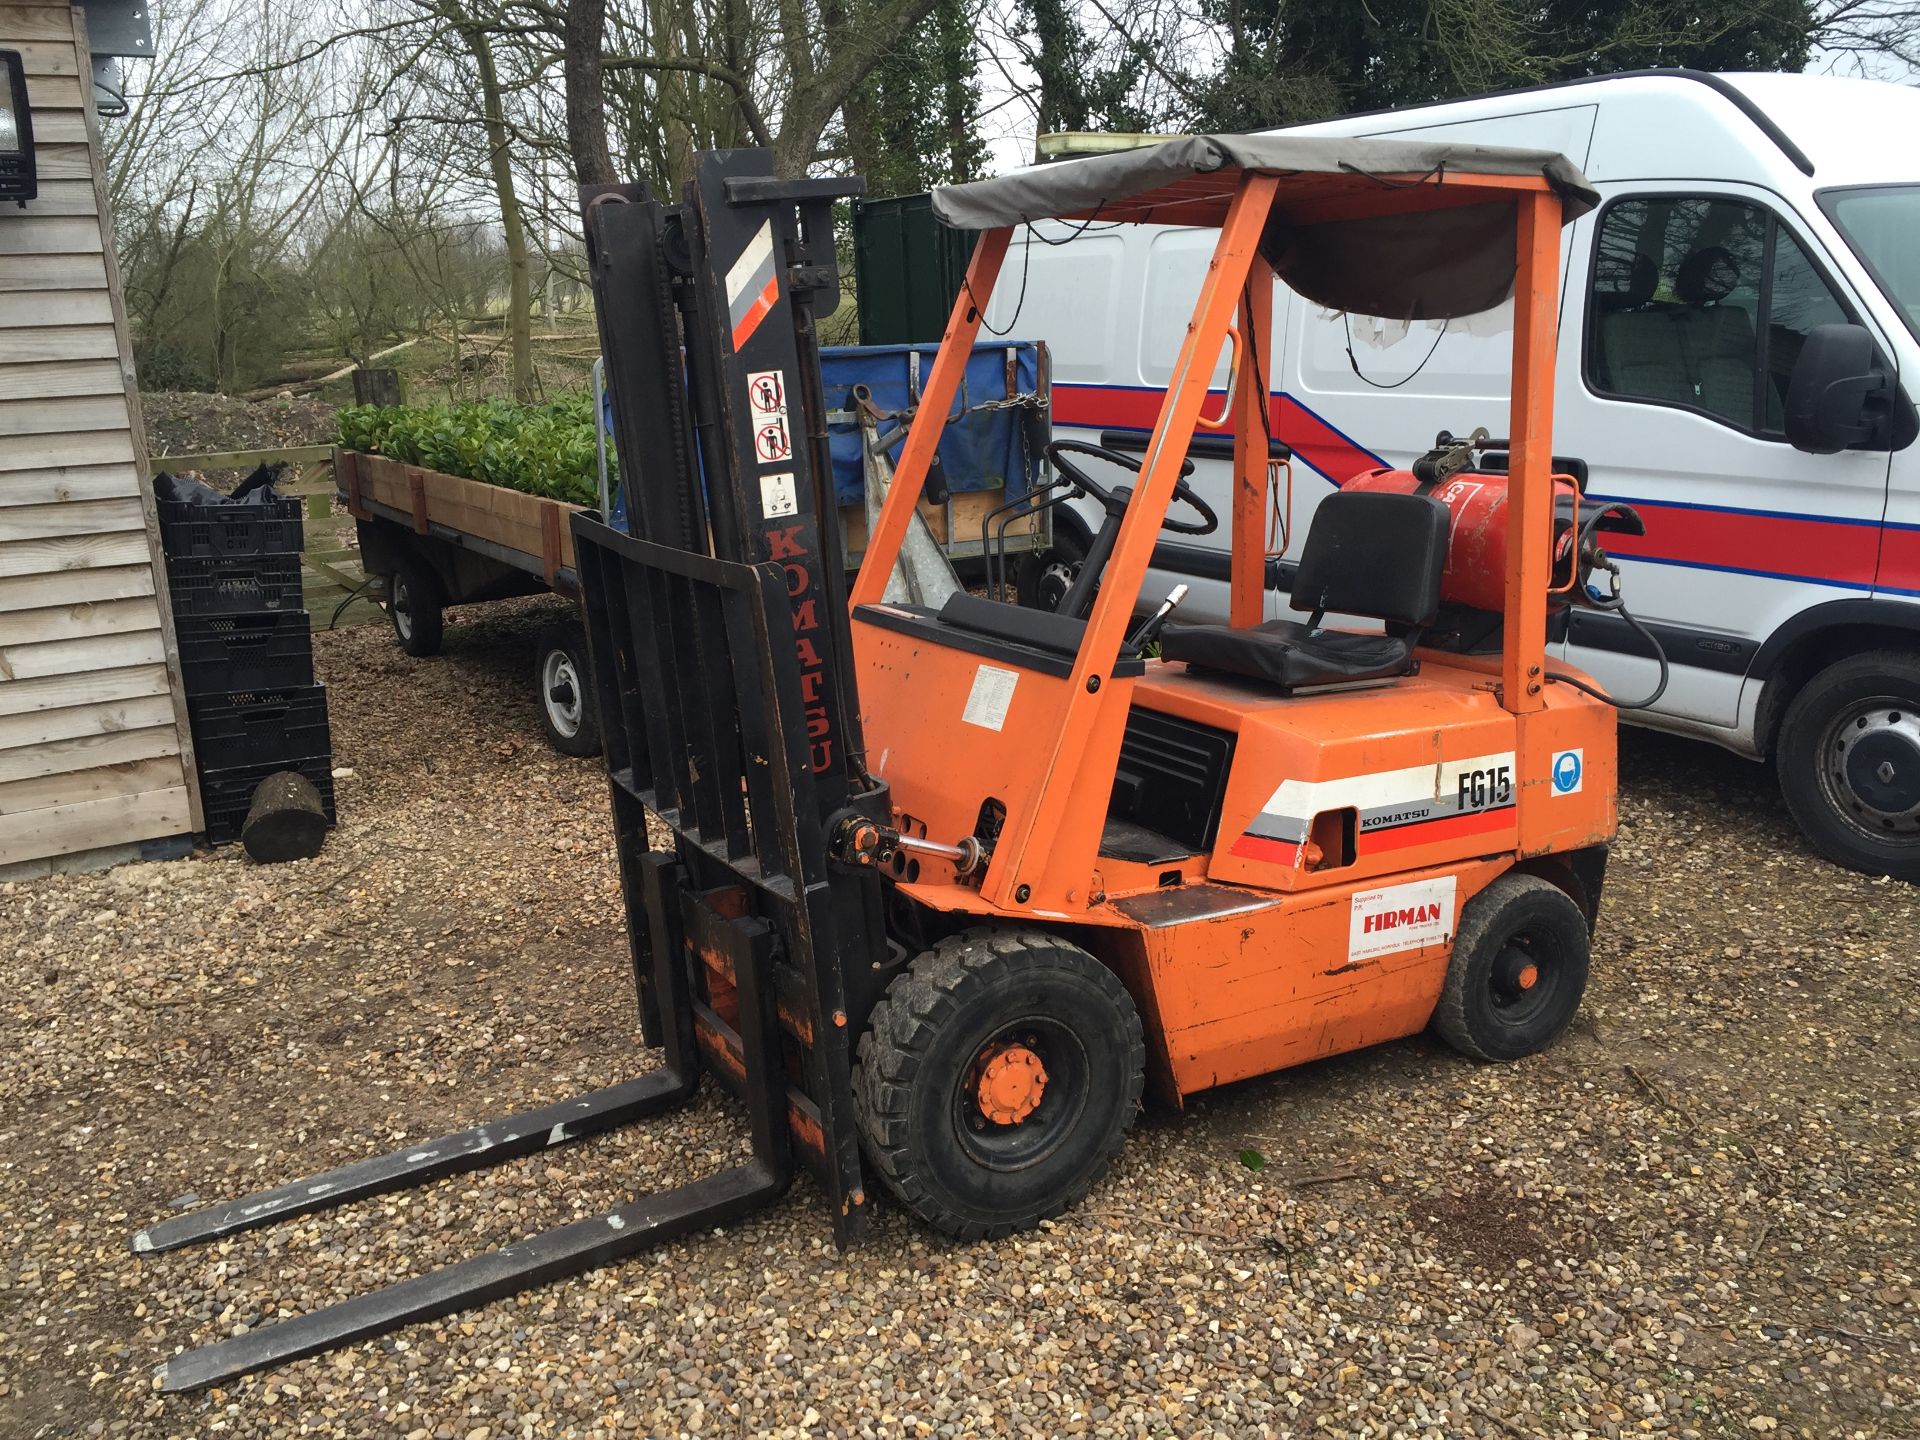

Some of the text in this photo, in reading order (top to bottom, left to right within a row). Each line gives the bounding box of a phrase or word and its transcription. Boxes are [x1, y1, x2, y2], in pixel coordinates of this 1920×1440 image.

[766, 525, 832, 773] KOMATSU
[1458, 766, 1510, 810] FG15
[1362, 809, 1430, 827] KOMATSU
[1354, 894, 1376, 904] Supplied
[1364, 902, 1441, 934] FIRMAN
